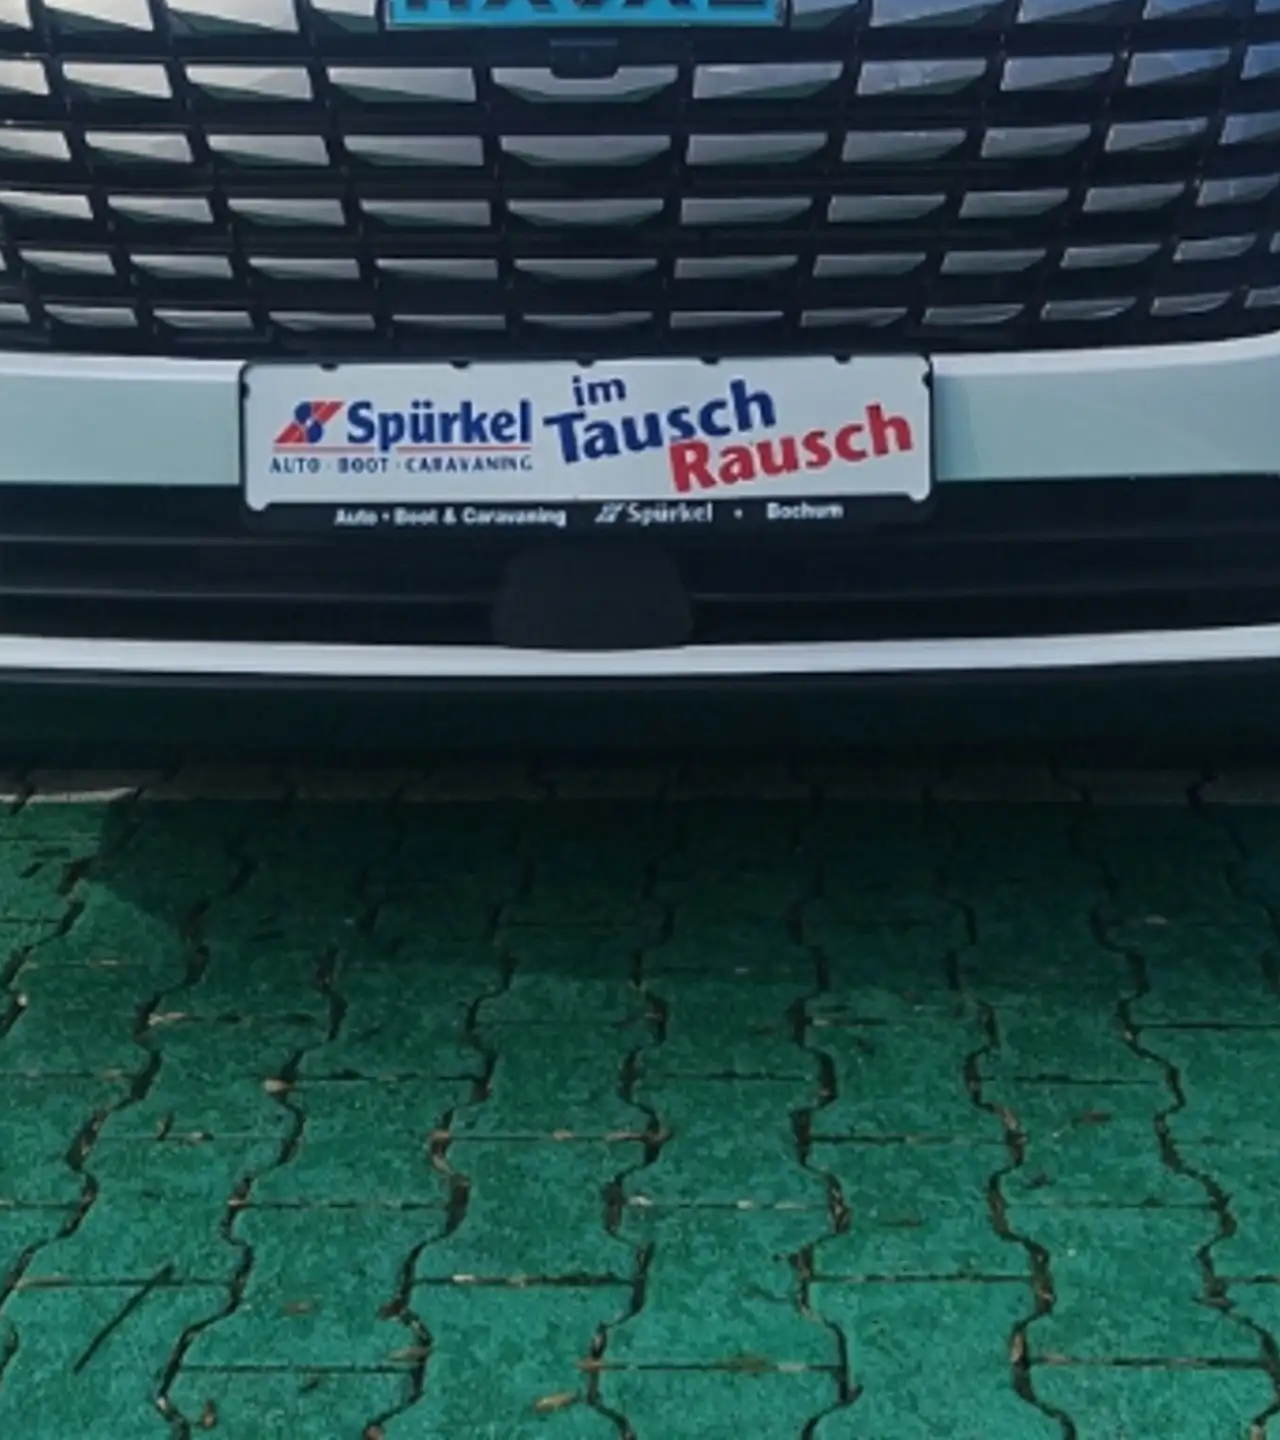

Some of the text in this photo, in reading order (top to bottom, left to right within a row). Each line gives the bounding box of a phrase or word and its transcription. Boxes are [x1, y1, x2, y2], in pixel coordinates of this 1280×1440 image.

[571, 375, 627, 408] im
[346, 400, 532, 452] Spürkel
[543, 378, 776, 464] Tausch
[270, 454, 533, 474] AUTO BOOT CARAVANING
[669, 402, 913, 493] Rausch
[334, 509, 378, 526] Auto
[393, 509, 439, 526] Boot
[627, 500, 713, 526] Spürkel
[766, 504, 844, 521] Bochum
